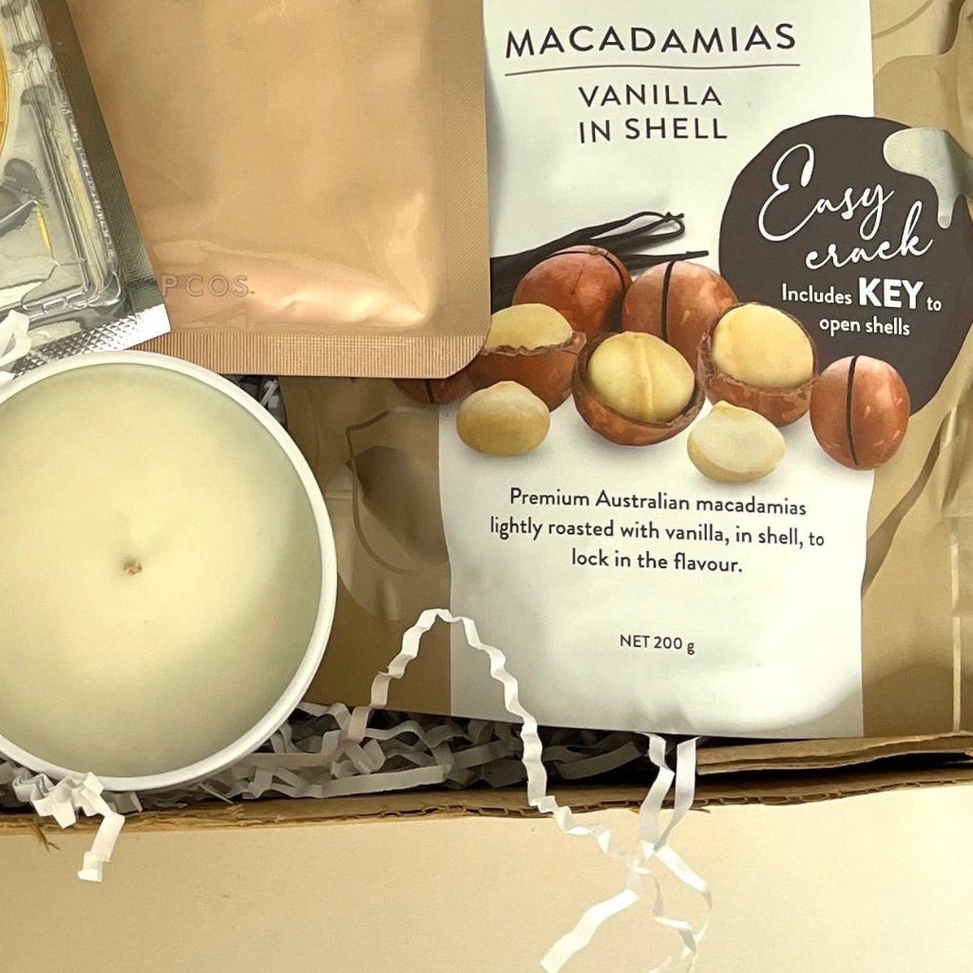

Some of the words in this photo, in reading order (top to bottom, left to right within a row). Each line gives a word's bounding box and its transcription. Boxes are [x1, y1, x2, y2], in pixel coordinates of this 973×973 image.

[505, 23, 797, 58] MACADAMIAS
[578, 84, 723, 107] VANILLA
[579, 120, 611, 144] IN
[625, 117, 728, 140] SHELL
[758, 143, 895, 242] Easy
[805, 200, 934, 270] crack
[782, 283, 853, 304] Includes
[858, 277, 924, 310] KEY
[927, 296, 943, 312] to
[819, 317, 861, 337] open
[865, 315, 911, 336] shells
[509, 487, 590, 507] Premium
[595, 489, 690, 511] Australian
[696, 495, 807, 516] macadamias
[490, 516, 543, 540] lightly
[548, 519, 614, 538] roasted
[620, 521, 660, 540] with
[665, 523, 731, 546] vanilla,
[735, 525, 753, 544] in
[758, 526, 804, 549] shell,
[809, 531, 825, 547] to
[572, 548, 610, 567] lock
[614, 550, 631, 568] in
[637, 551, 668, 569] the
[673, 552, 744, 574] flavour.
[619, 633, 651, 649] NET
[653, 635, 684, 651] 200
[686, 641, 696, 656] g
